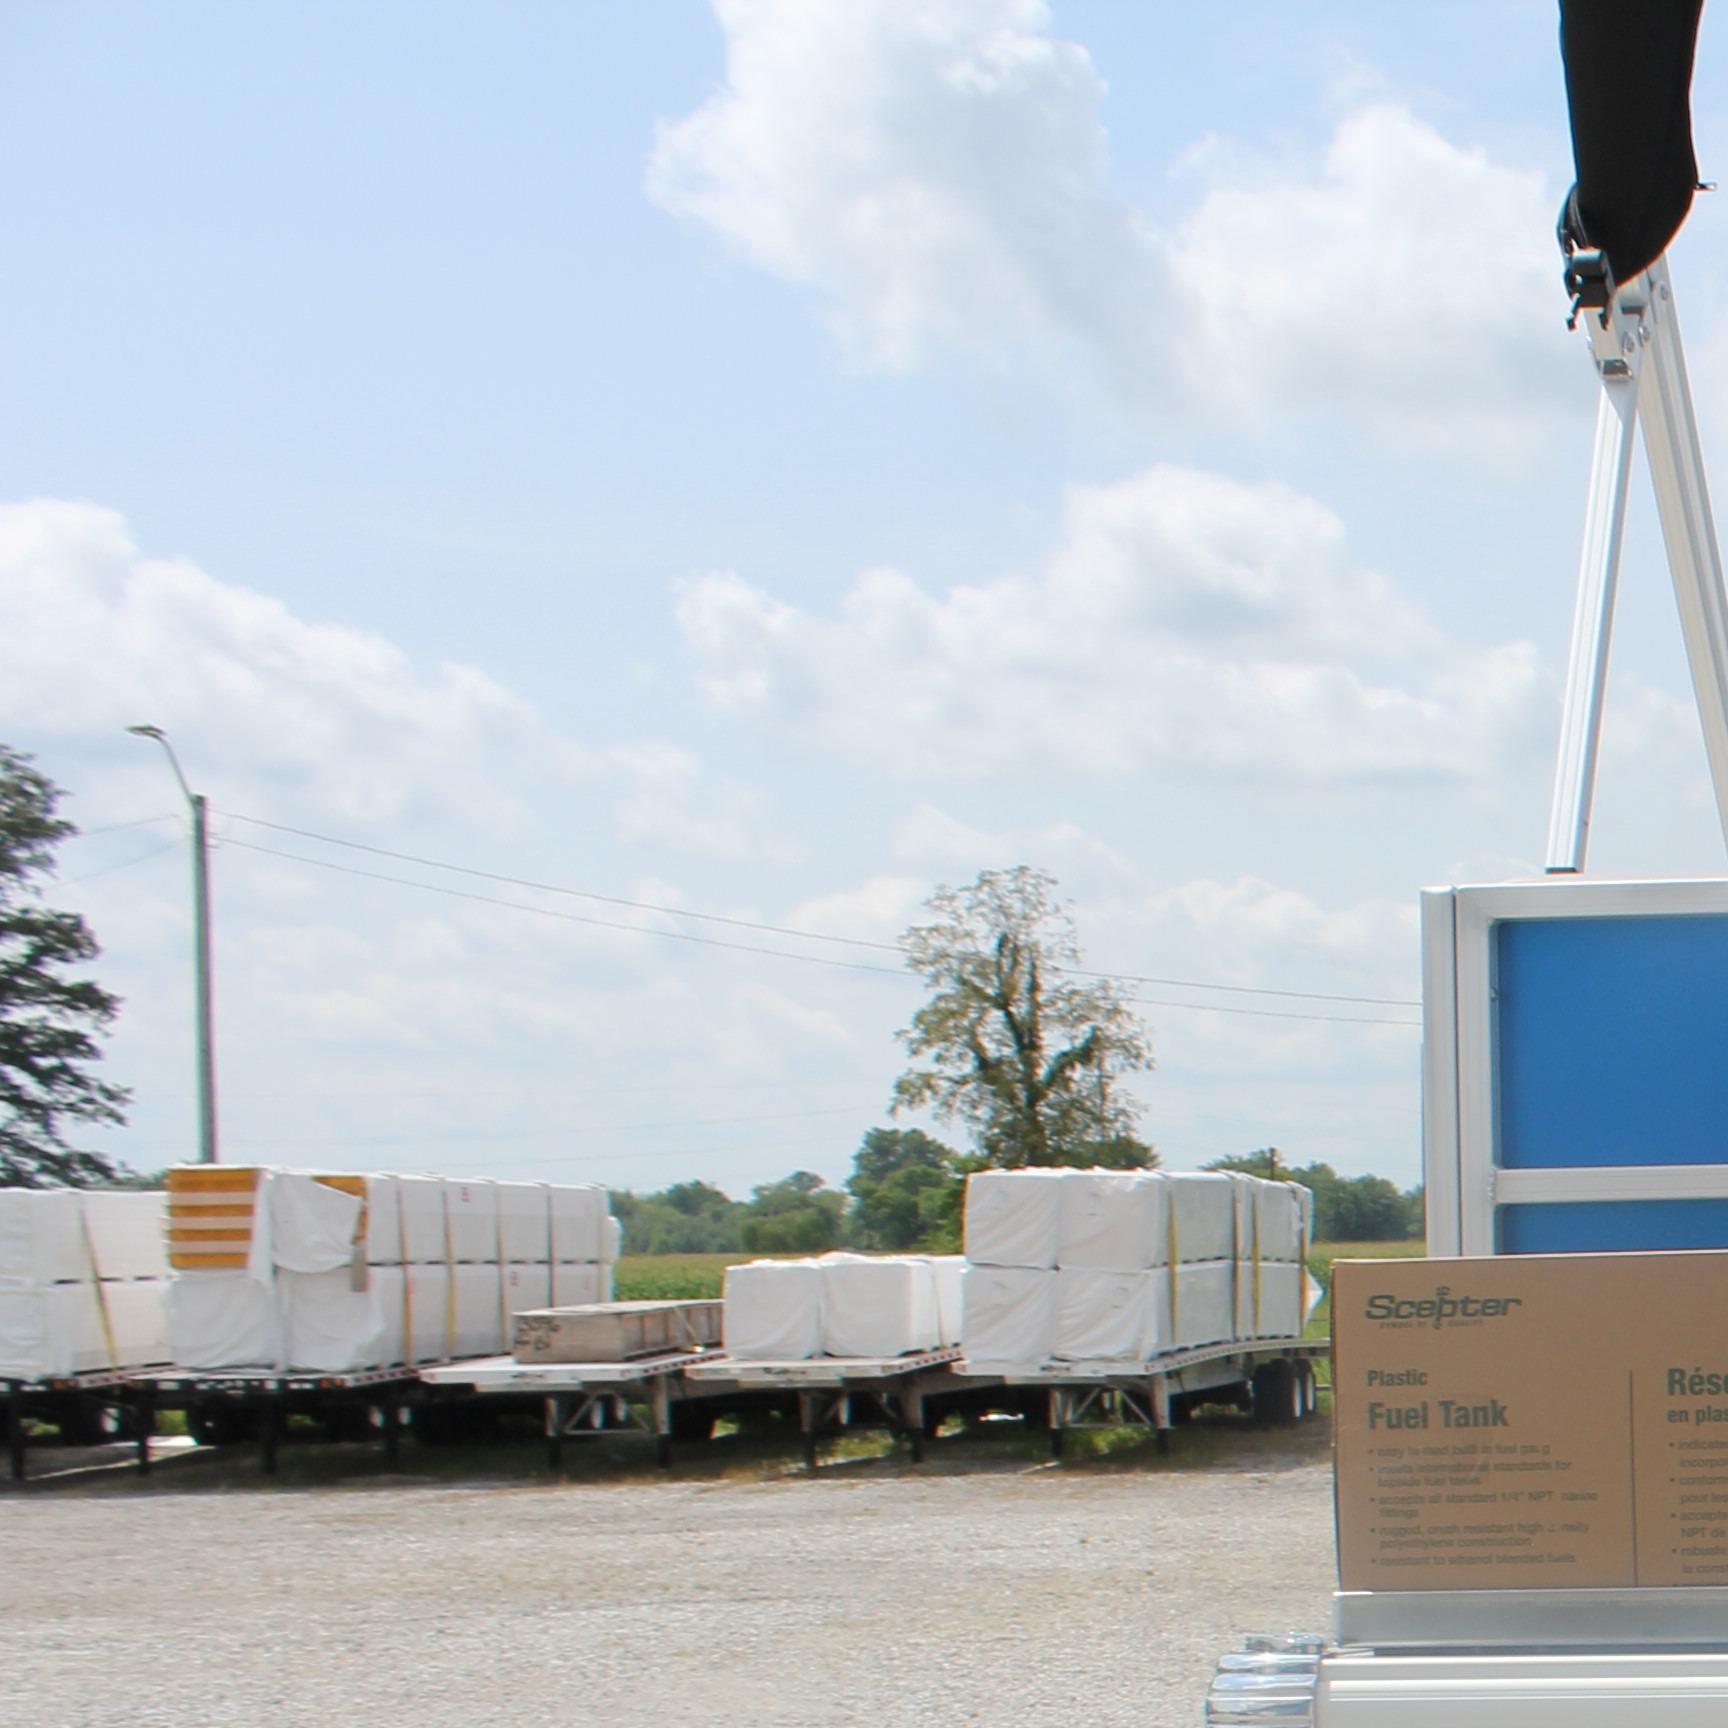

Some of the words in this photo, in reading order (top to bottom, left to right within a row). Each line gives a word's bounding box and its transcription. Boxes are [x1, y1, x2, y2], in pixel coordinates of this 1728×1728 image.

[1364, 1286, 1523, 1329] Scepter
[1367, 1369, 1428, 1386] Plastic
[1368, 1401, 1429, 1430] Fuel
[1436, 1399, 1509, 1429] Tank
[1667, 1408, 1689, 1423] en
